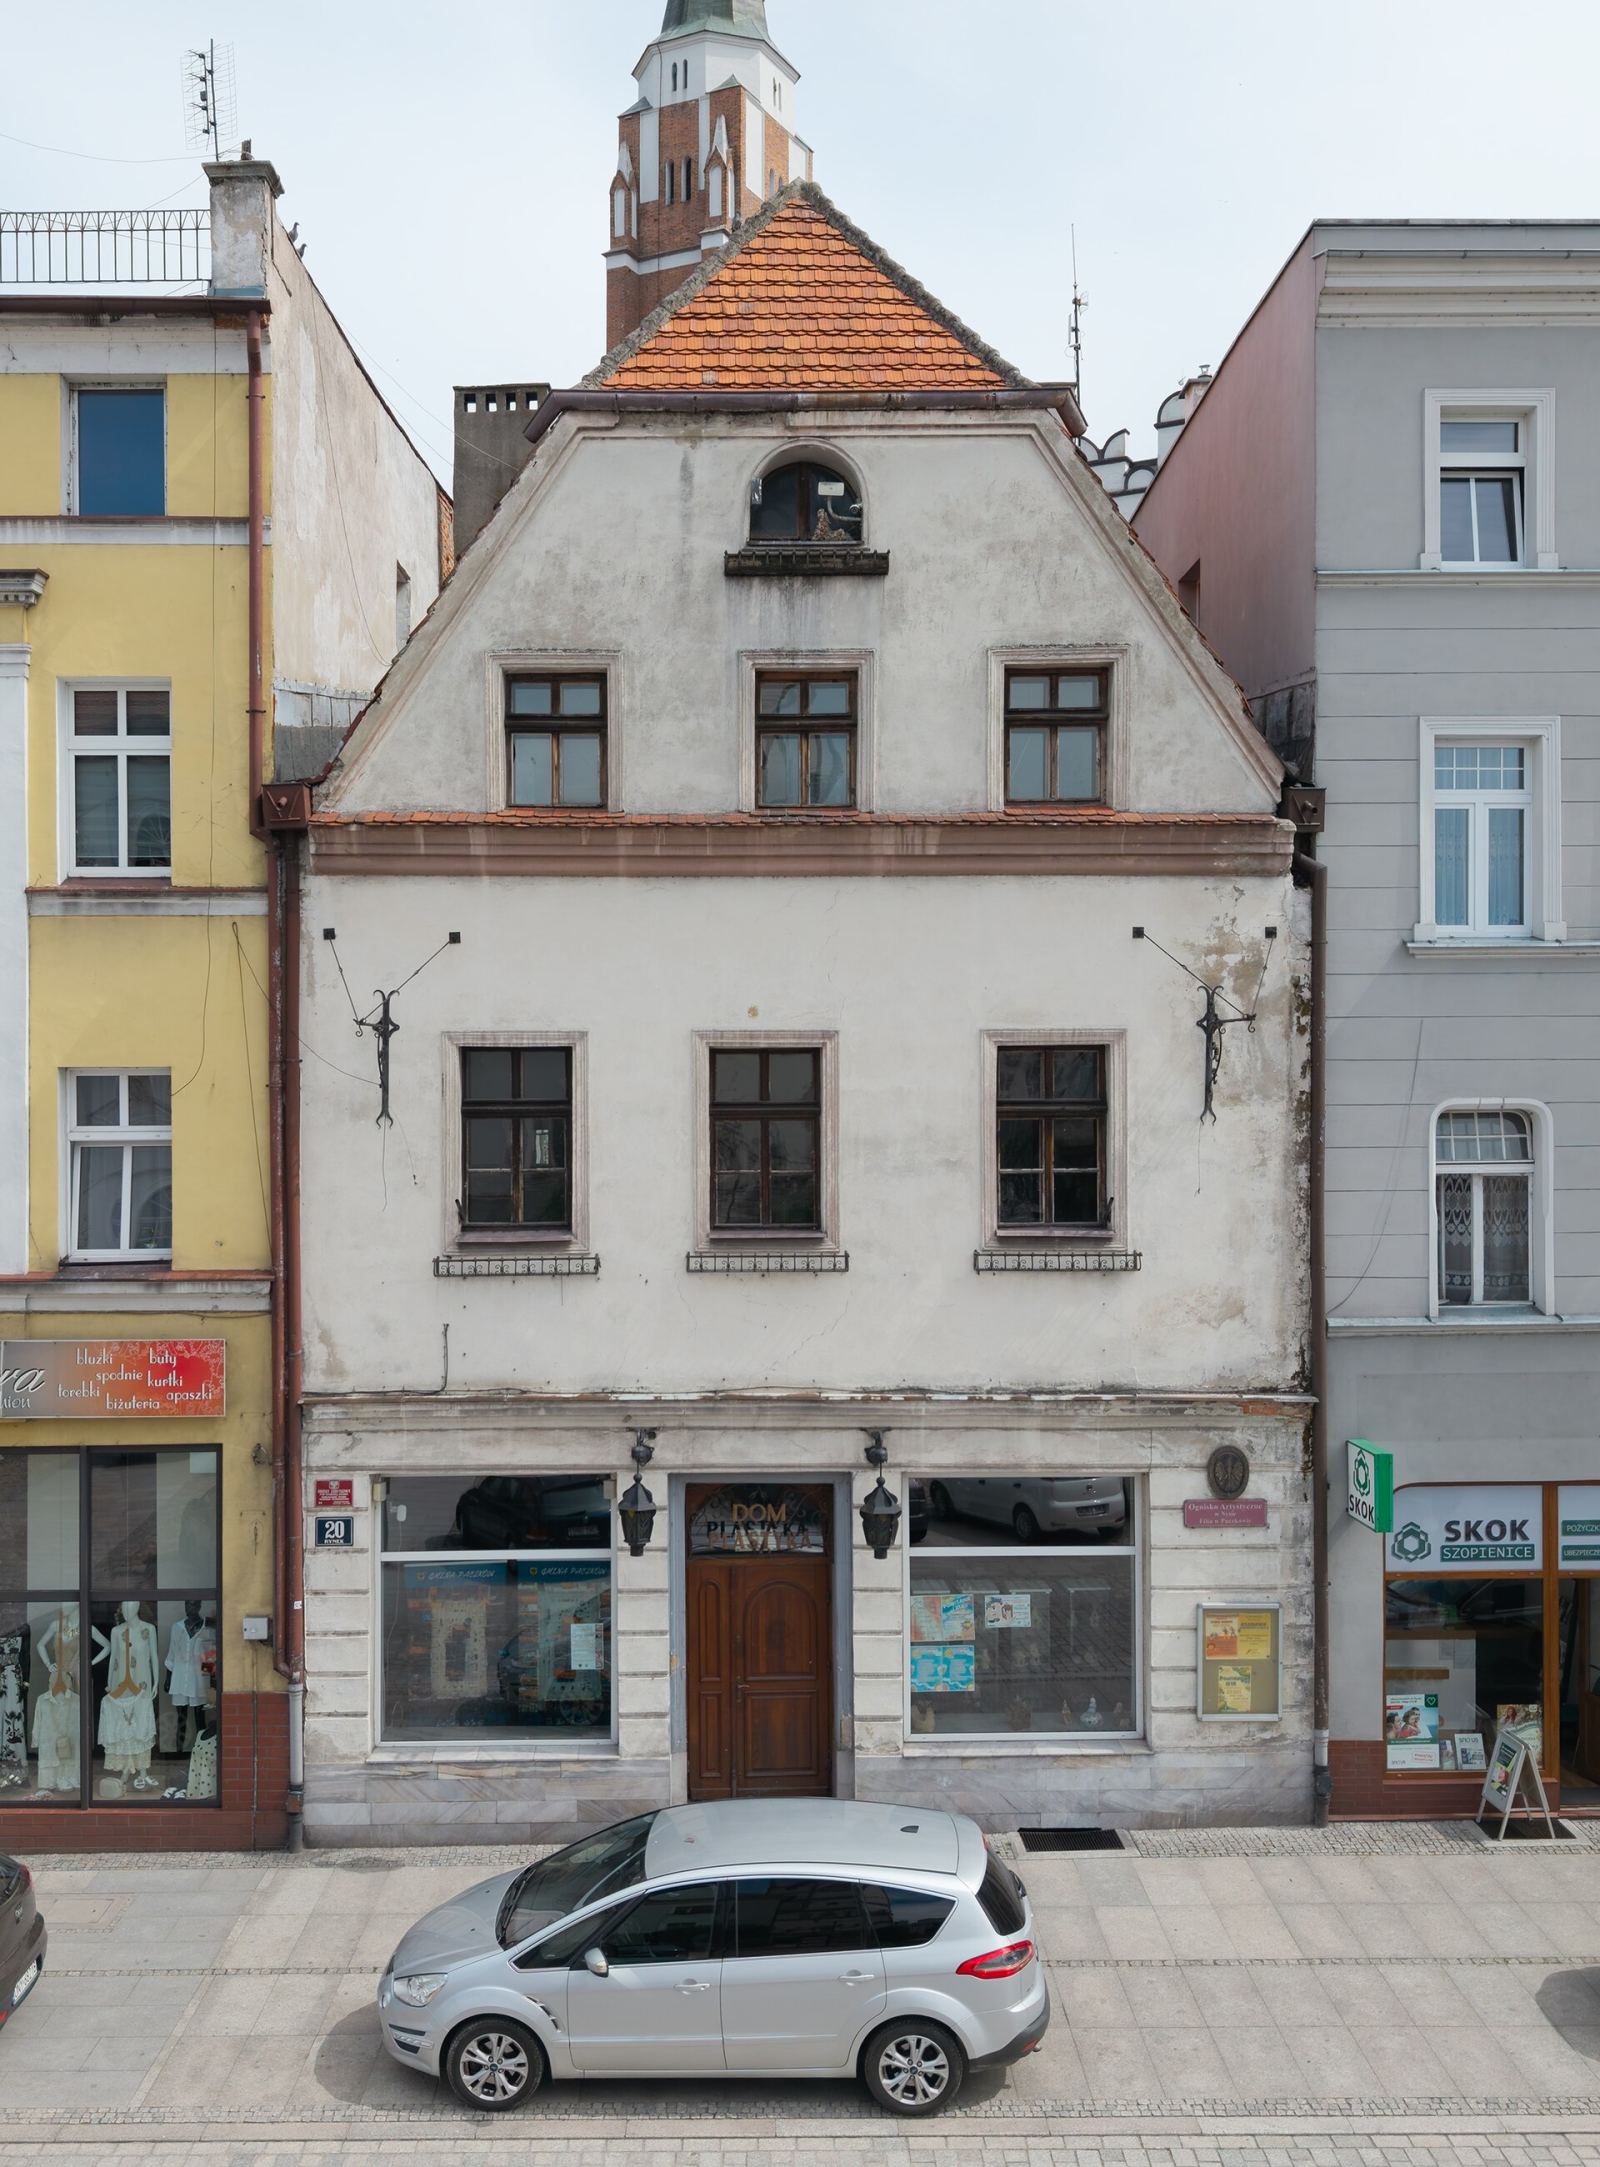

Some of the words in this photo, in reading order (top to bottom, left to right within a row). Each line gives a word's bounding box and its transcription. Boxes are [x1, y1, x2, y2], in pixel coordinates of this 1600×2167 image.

[76, 1347, 113, 1365] bluzki
[149, 1348, 177, 1366] buty
[96, 1364, 143, 1384] spodnie
[147, 1370, 183, 1387] kurtki
[58, 1382, 100, 1397] torebki
[166, 1384, 212, 1403] apaszki
[106, 1393, 160, 1410] biżuteria
[732, 1503, 787, 1522] DOM
[1349, 1494, 1375, 1524] SKOK
[325, 1521, 345, 1539] 20
[1444, 1519, 1530, 1542] SKOK
[1443, 1546, 1532, 1559] SZOPIENICE
